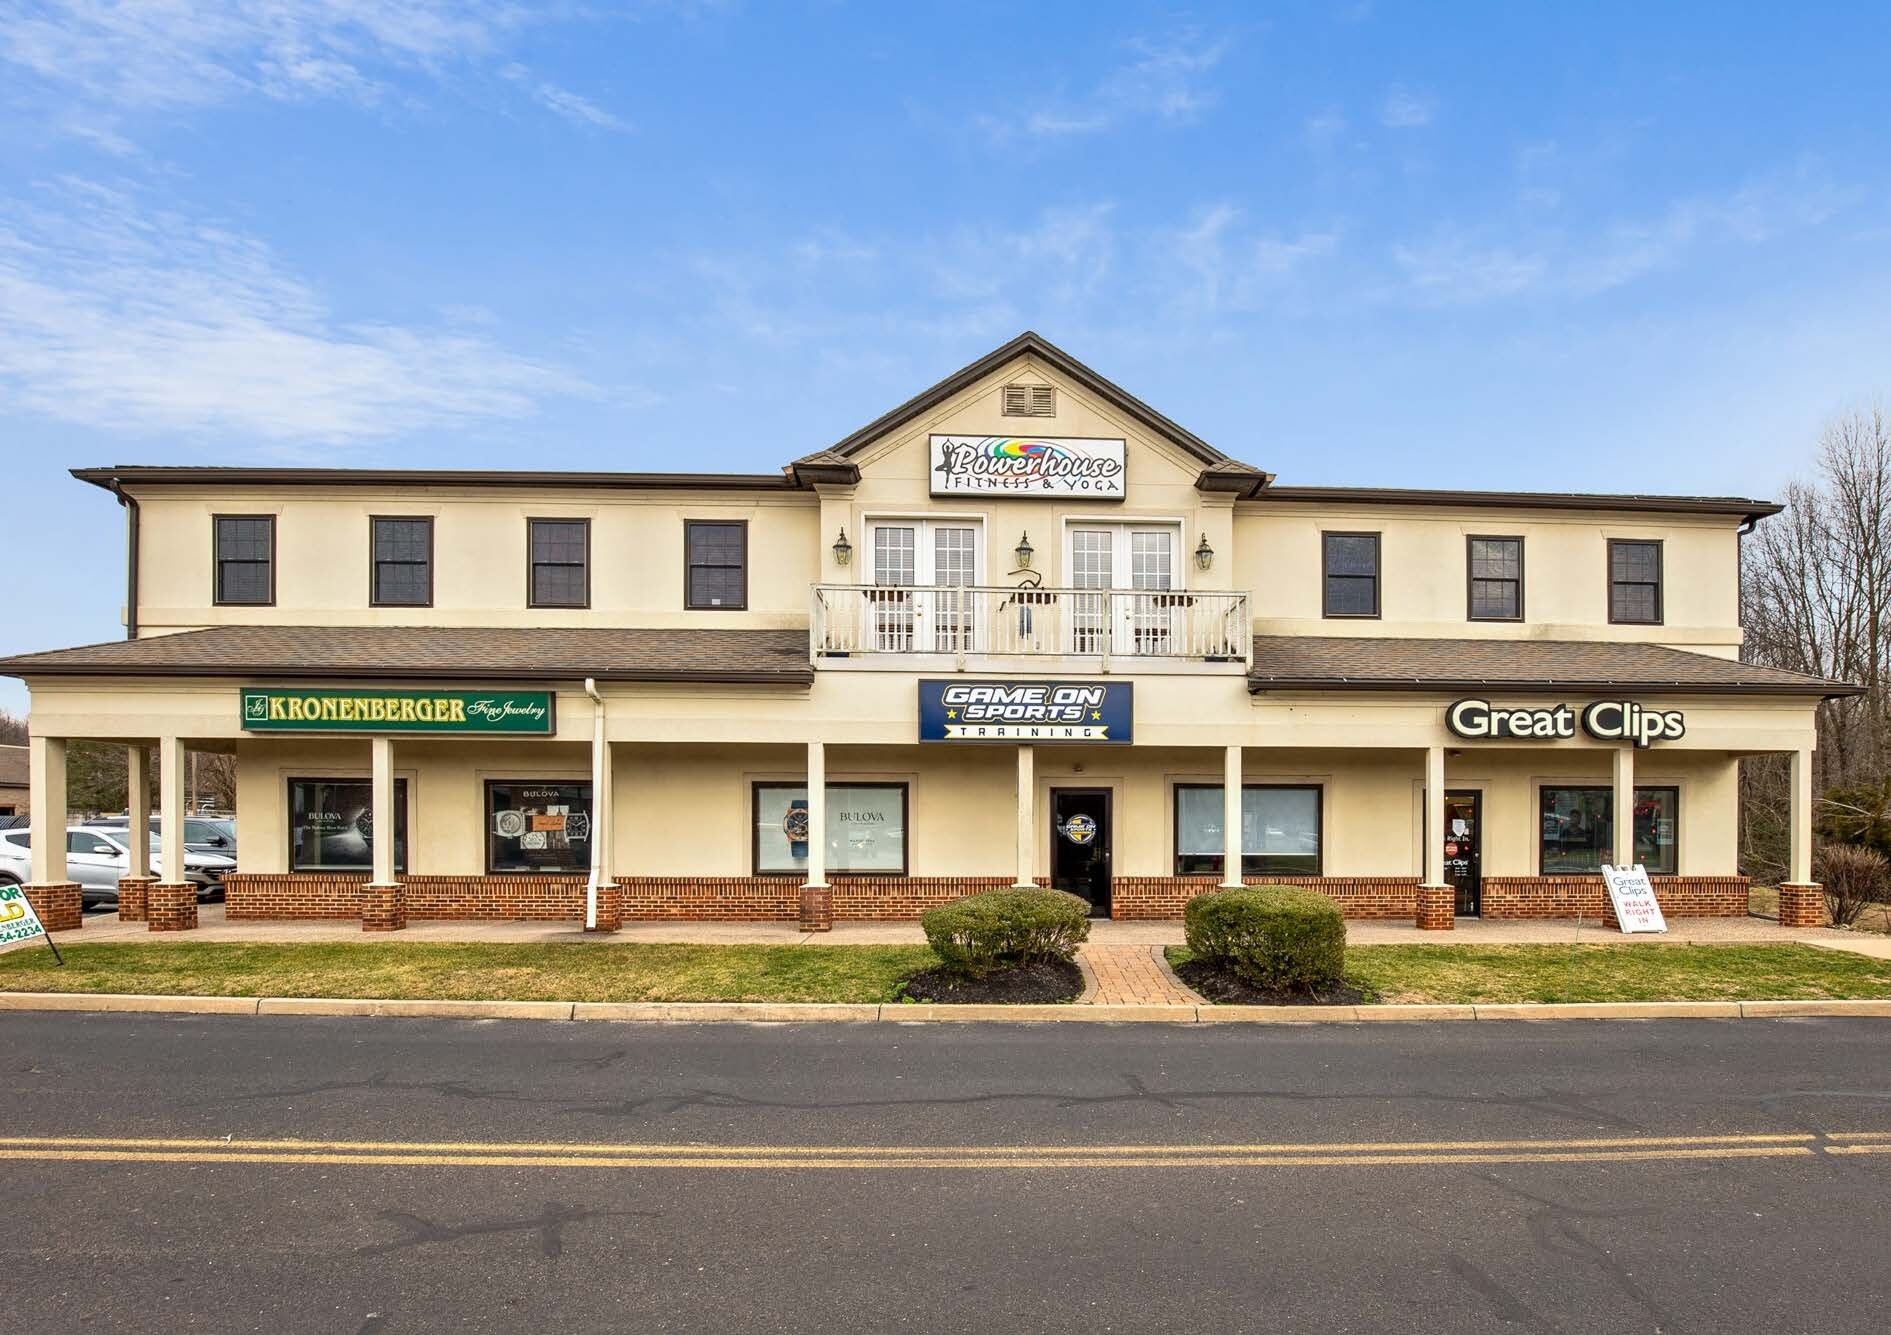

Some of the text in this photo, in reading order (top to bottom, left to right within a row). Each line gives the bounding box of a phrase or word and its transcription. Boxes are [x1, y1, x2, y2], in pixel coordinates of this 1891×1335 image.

[952, 443, 1122, 477] Powerhouse
[955, 477, 1119, 491] FITNESS & YOGA
[945, 687, 1102, 704] GAME ON
[269, 697, 466, 721] KRONENBERGER
[467, 700, 545, 722] Fine Jewelry
[965, 705, 1083, 719] SPORTS
[1450, 699, 1684, 746] Great Clips
[960, 727, 1092, 737] TRAINING
[308, 812, 342, 820] BULOVA
[840, 811, 885, 821] BULOVA
[1613, 876, 1647, 886] Great
[1618, 886, 1648, 897] Clips
[1625, 908, 1655, 916] RIGHT
